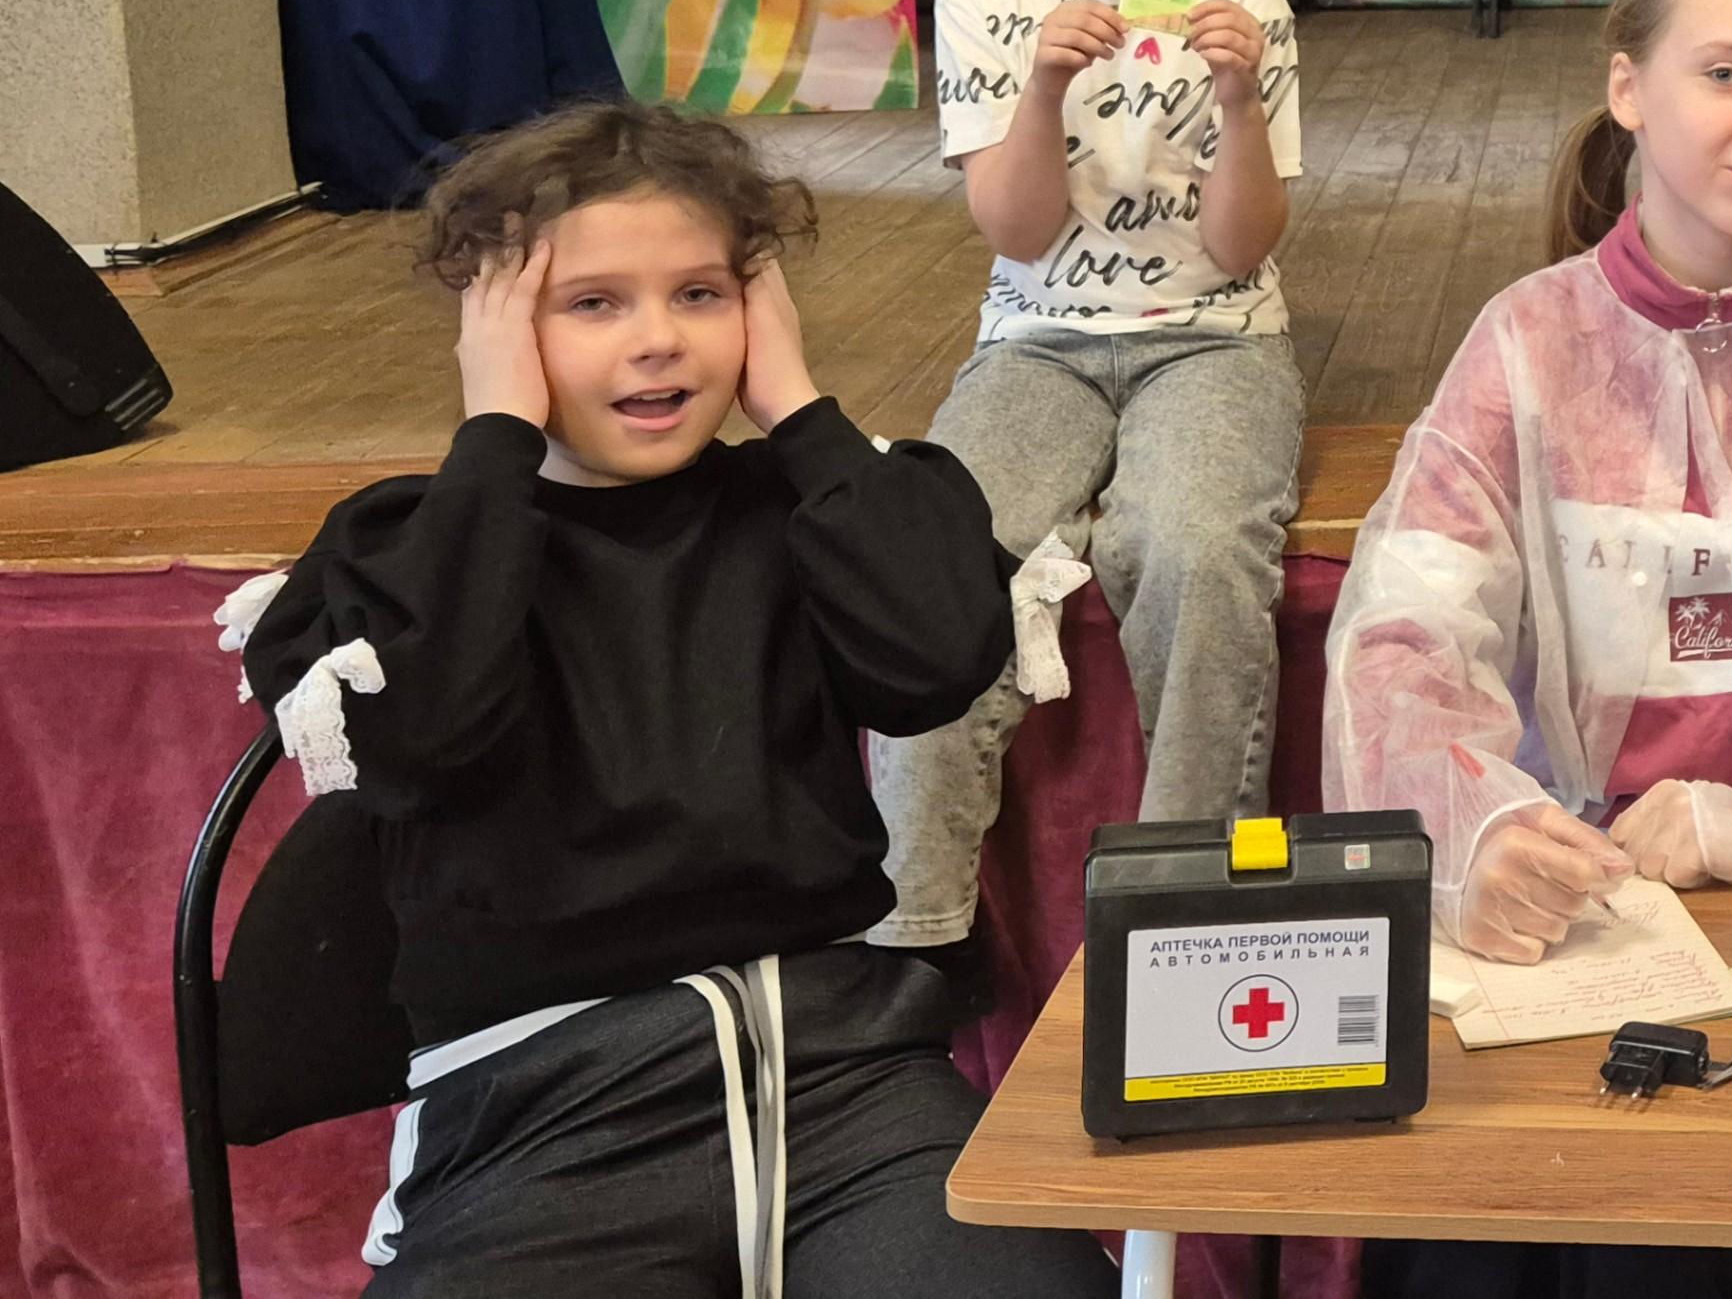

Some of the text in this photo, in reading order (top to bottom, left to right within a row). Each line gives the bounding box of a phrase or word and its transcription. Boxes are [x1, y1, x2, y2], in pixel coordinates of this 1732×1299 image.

[1044, 224, 1184, 289] love
[1150, 930, 1370, 953] АПТЕЧКА ПЕРВОЙ ПОМОЩИ
[1150, 946, 1370, 968] АВТОМОБИЛЬНАЯ
